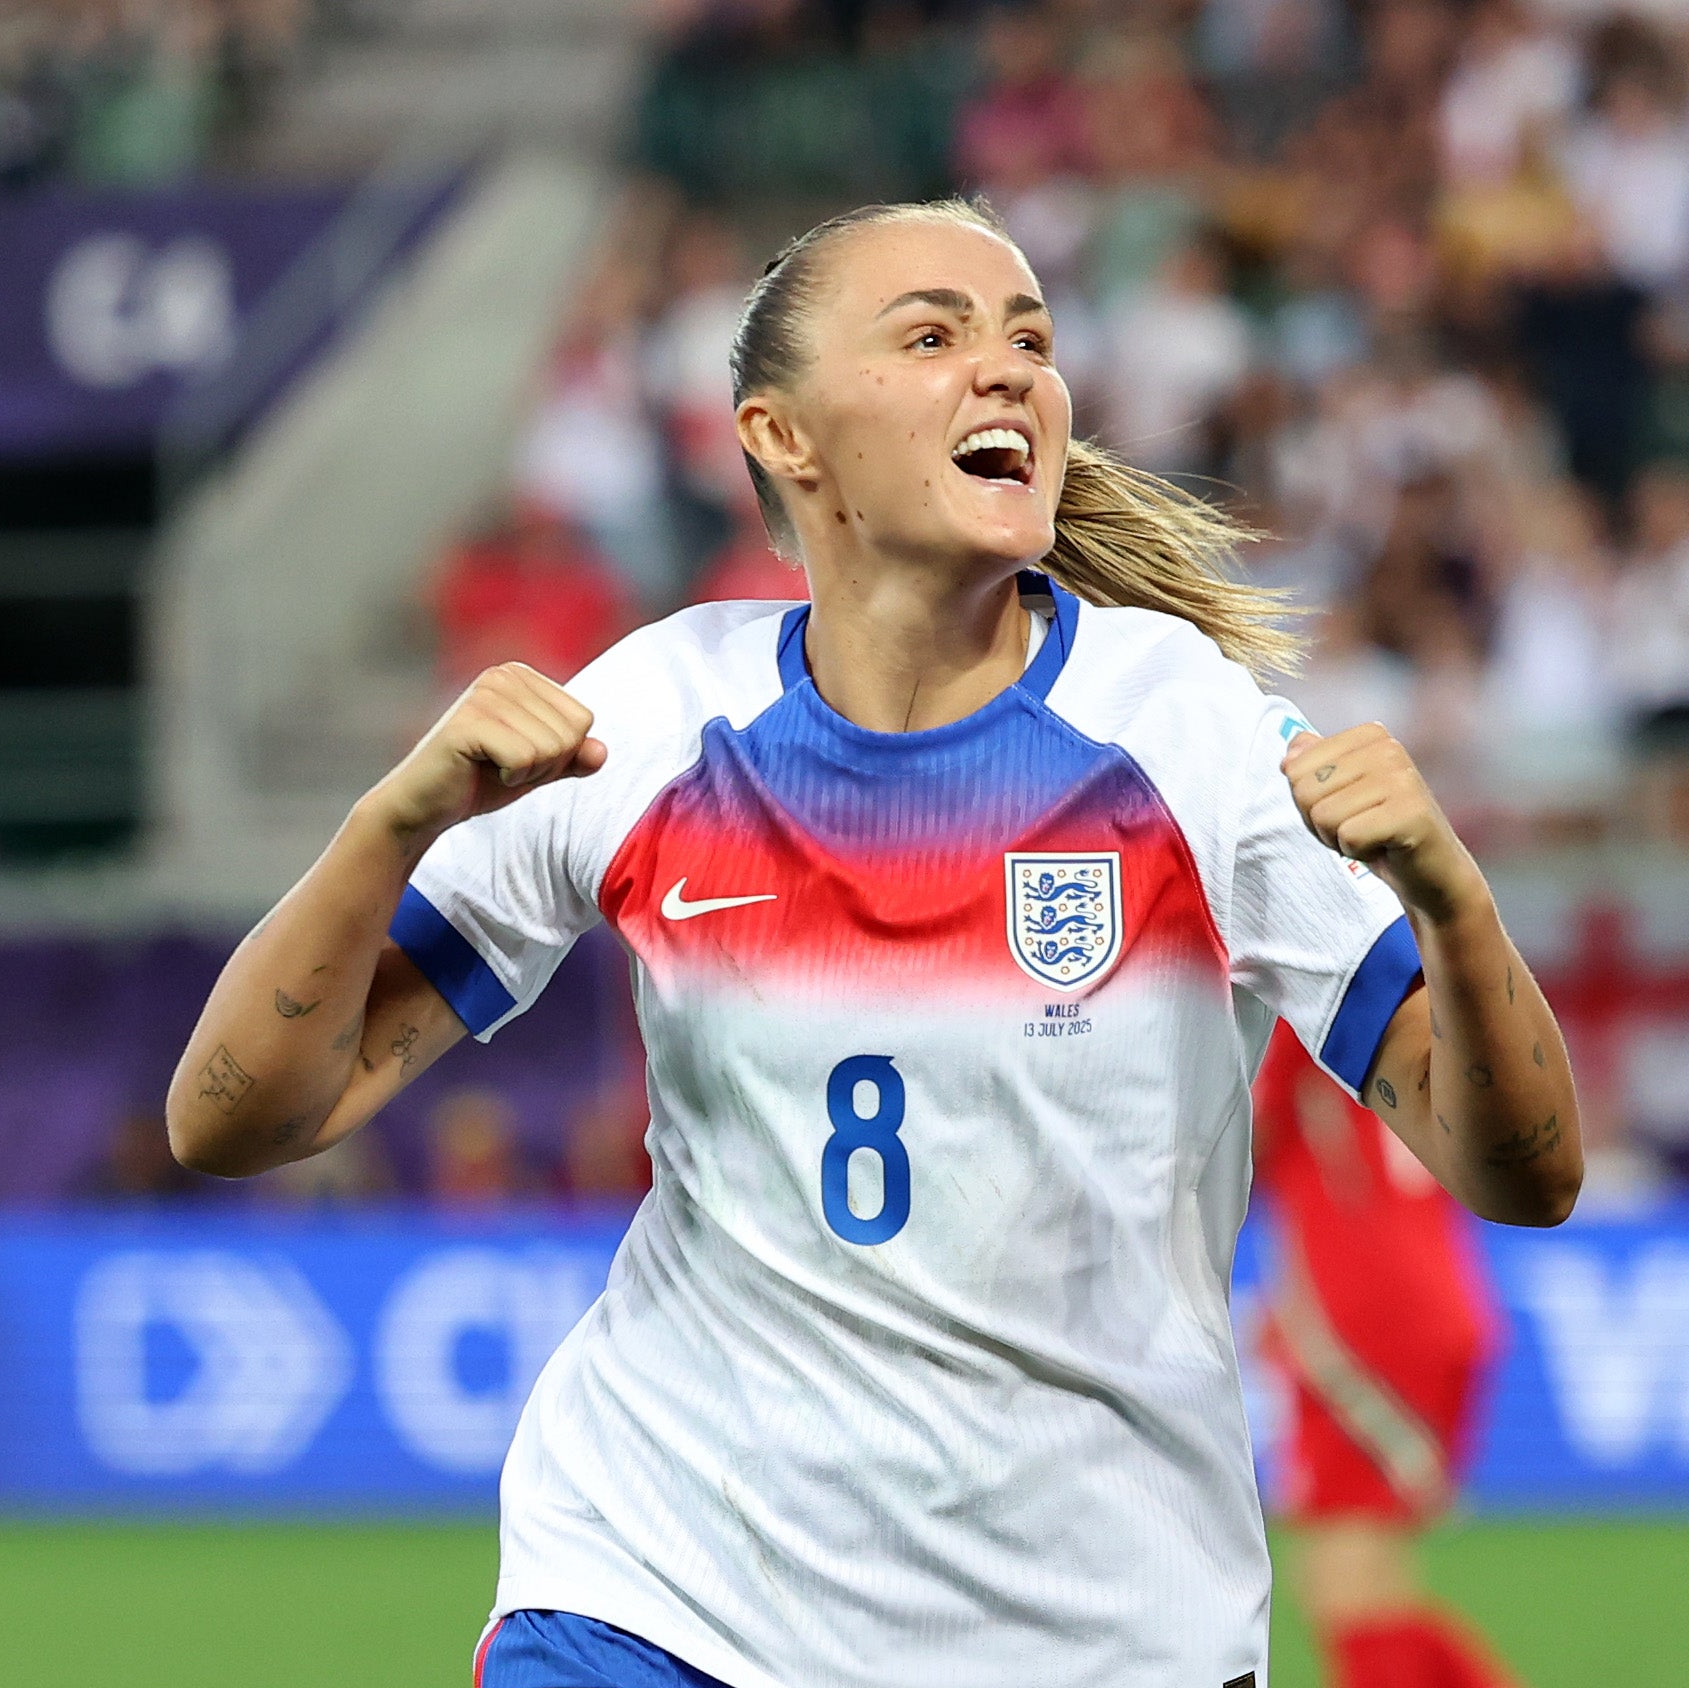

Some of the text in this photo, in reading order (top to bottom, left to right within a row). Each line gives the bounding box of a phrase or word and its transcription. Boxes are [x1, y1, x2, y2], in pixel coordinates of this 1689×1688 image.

[1044, 1003, 1080, 1018] WALES
[1023, 1018, 1092, 1037] 13 JULY 2025
[821, 1055, 911, 1246] 8
